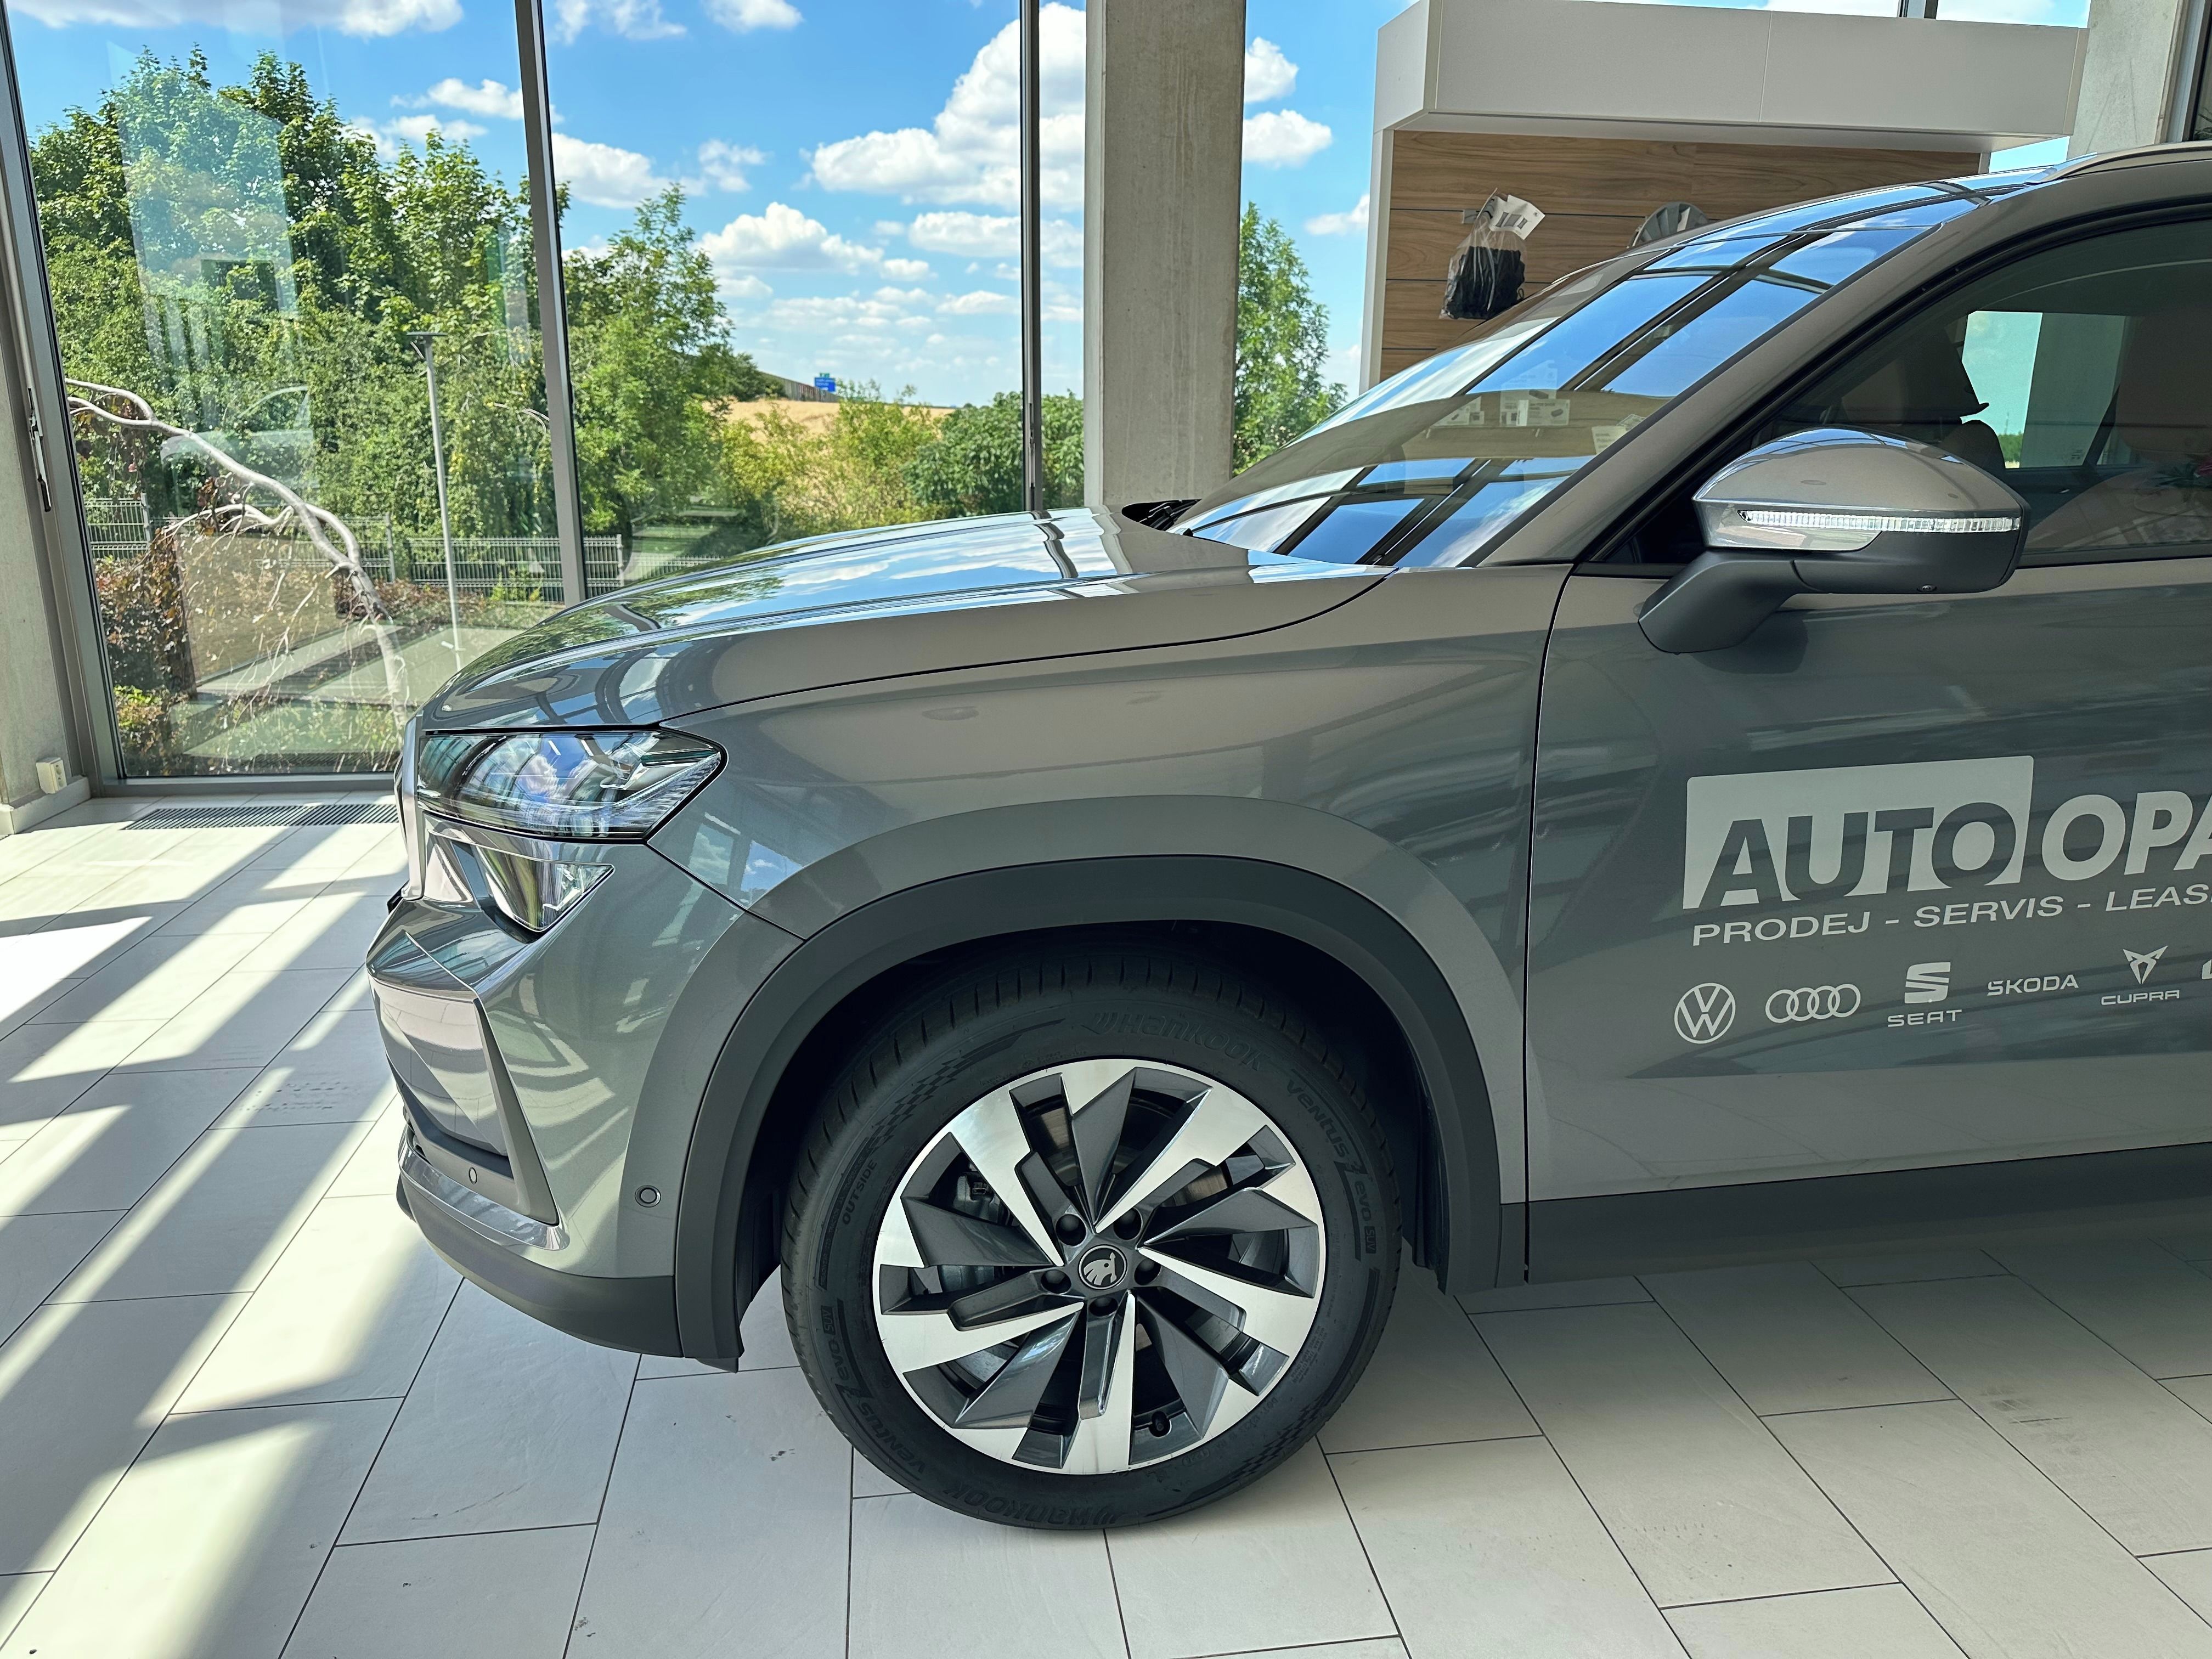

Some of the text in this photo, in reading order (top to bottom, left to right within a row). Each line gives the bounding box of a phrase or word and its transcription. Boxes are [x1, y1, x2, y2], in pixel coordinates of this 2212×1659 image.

[1700, 802, 2016, 907] AUTO
[1692, 911, 1870, 946] PRODEJ
[1914, 895, 2064, 927] SERVIS
[2106, 883, 2212, 911] LEAS
[1887, 1009, 1962, 1028] SEAT
[2101, 990, 2180, 1006] CUPRA
[843, 1160, 877, 1225] OUTSIDE
[1365, 1226, 1376, 1253] SUV
